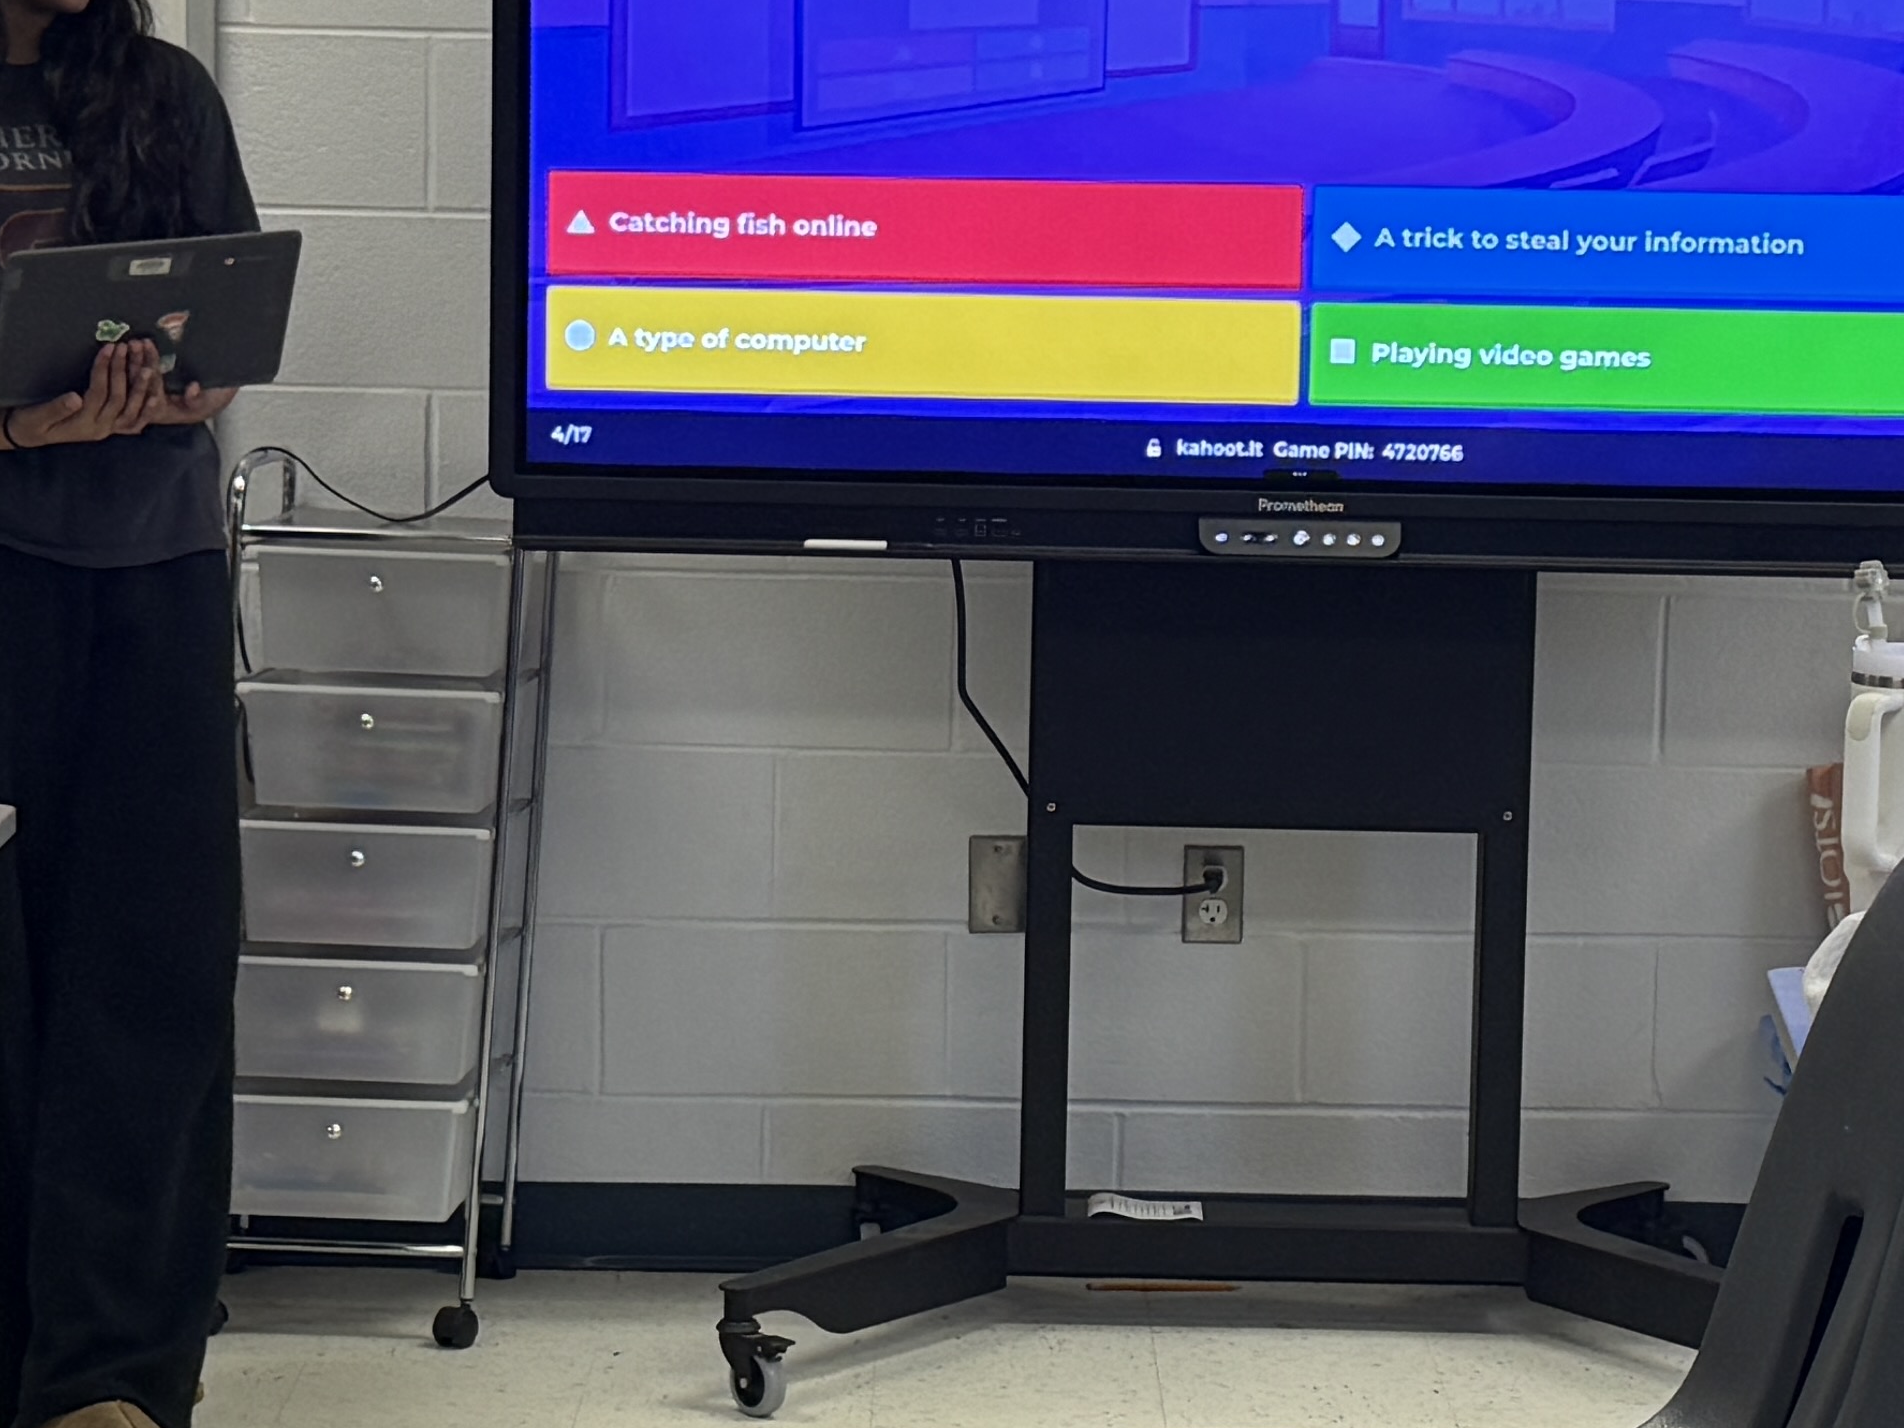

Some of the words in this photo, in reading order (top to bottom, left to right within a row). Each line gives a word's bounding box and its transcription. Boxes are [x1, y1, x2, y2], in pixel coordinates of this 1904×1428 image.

[609, 211, 730, 239] Catching
[736, 213, 787, 237] fish
[793, 215, 878, 238] online
[1374, 227, 1396, 248] A
[1403, 226, 1464, 250] trick
[1471, 228, 1499, 251] to
[1506, 228, 1570, 252] steal
[1575, 234, 1637, 255] your
[1645, 230, 1804, 256] information
[608, 327, 629, 348] A
[635, 327, 695, 351] type
[701, 328, 729, 349] of
[735, 330, 866, 356] computer
[1371, 342, 1472, 369] Playing
[1478, 342, 1554, 367] video
[1560, 346, 1652, 371] games
[550, 424, 593, 447] 4/17
[1176, 438, 1263, 458] kahoot.it
[1273, 441, 1330, 459] Game
[1334, 442, 1375, 460] PIN:
[1382, 444, 1464, 462] 4720766
[1257, 497, 1344, 513] Promethean
